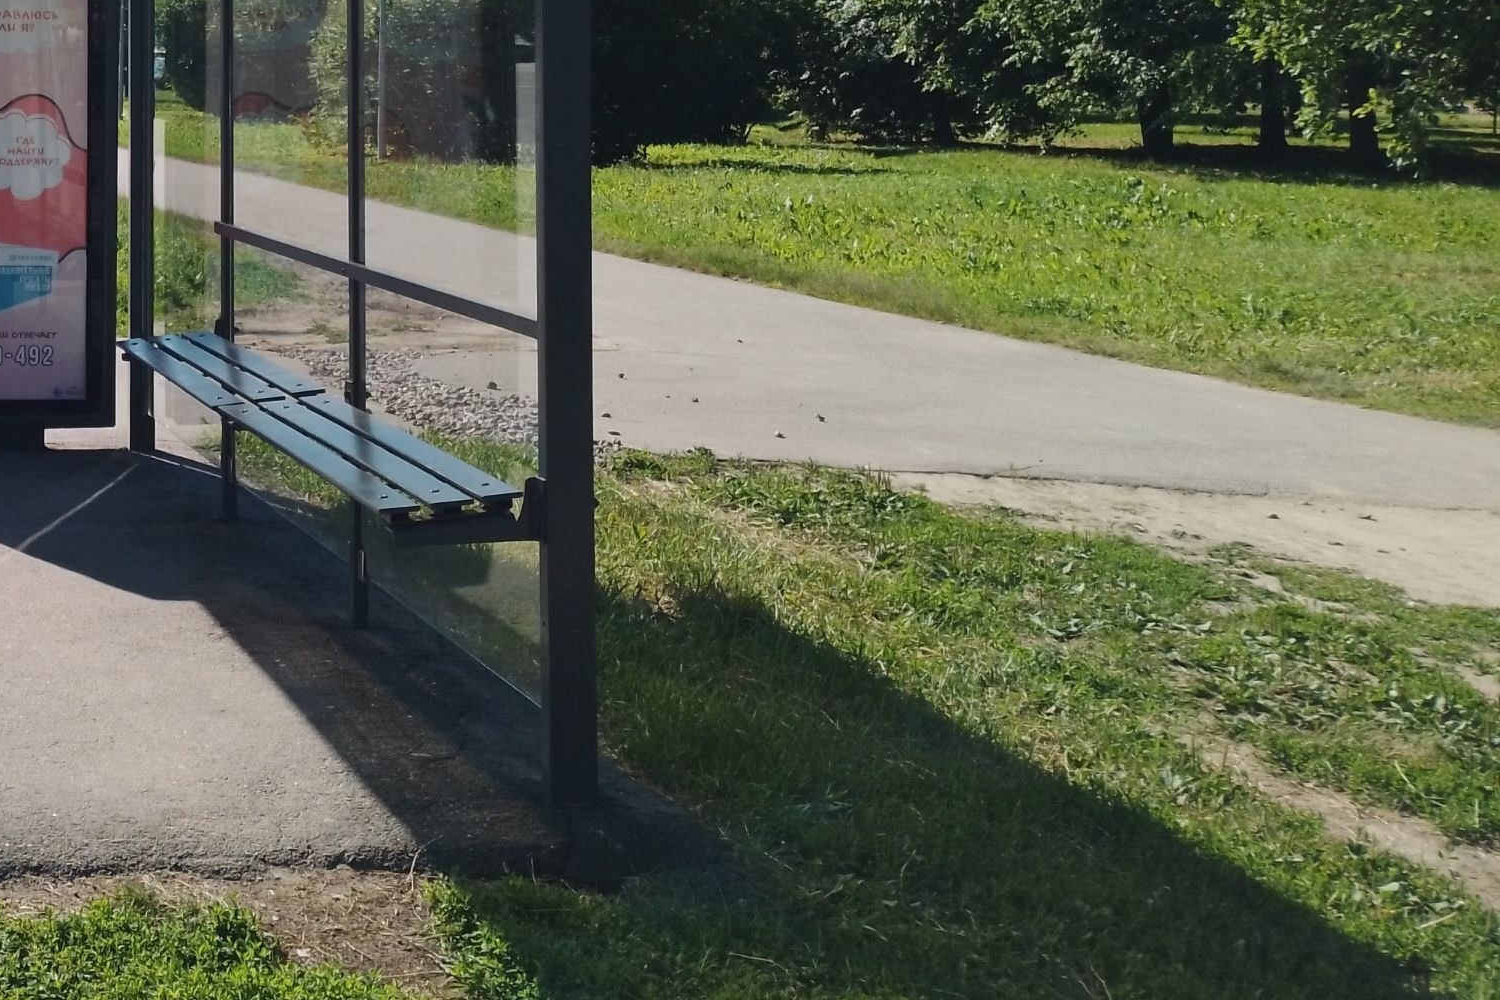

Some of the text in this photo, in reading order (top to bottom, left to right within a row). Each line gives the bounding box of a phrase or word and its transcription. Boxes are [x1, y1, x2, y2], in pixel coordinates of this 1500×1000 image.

[20, 22, 36, 33] Я?
[16, 136, 35, 145] ГДЕ
[11, 330, 58, 340] ОТВЕЧАЕТ
